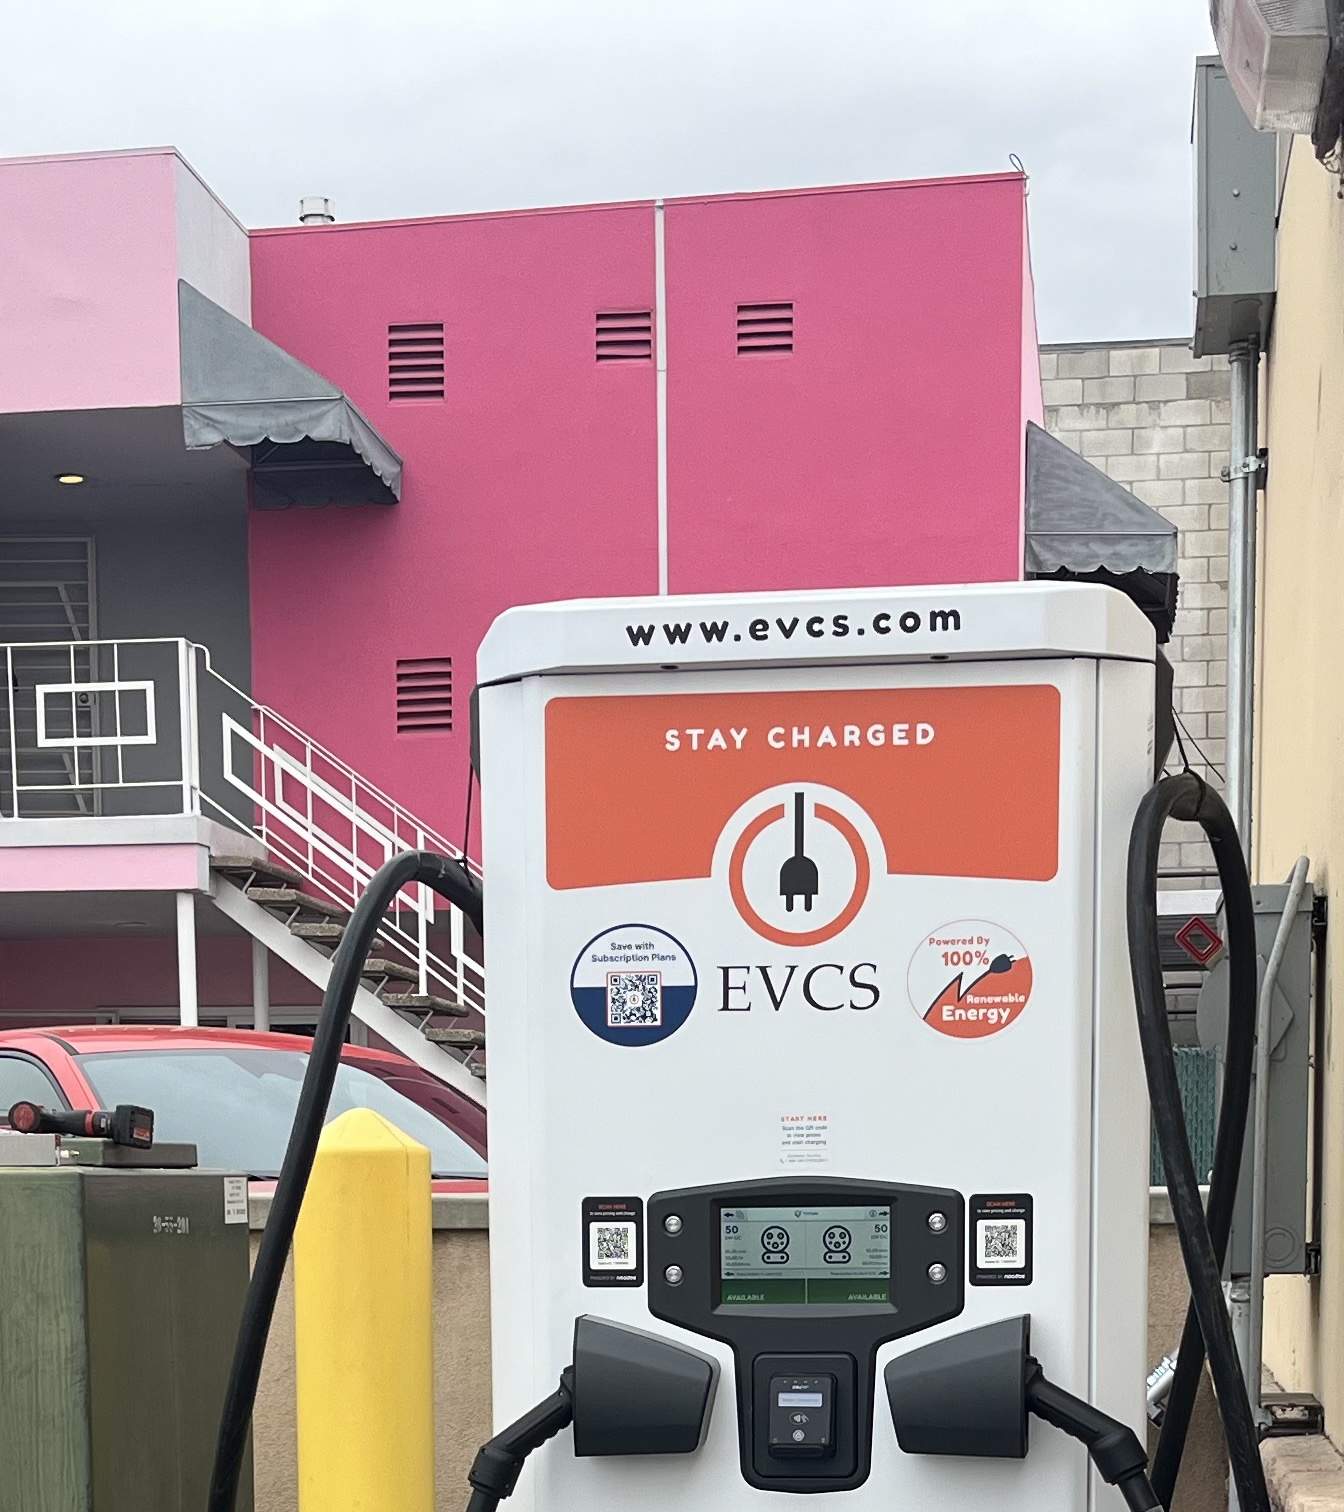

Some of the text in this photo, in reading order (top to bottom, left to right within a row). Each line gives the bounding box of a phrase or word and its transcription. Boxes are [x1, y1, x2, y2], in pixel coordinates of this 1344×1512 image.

[626, 609, 961, 647] www.evcs.com
[665, 722, 935, 751] STAY CHARGED
[610, 941, 654, 951] Save with
[928, 936, 990, 947] Powered By
[592, 953, 676, 963] Subscription Plans
[942, 949, 990, 966] 100%
[716, 963, 880, 1012] EVCS
[966, 993, 1025, 1004] Renewable
[942, 1005, 1010, 1024] Energy
[725, 1225, 738, 1234] 50
[874, 1224, 888, 1233] 50
[848, 1293, 886, 1301] AVAILABLE
